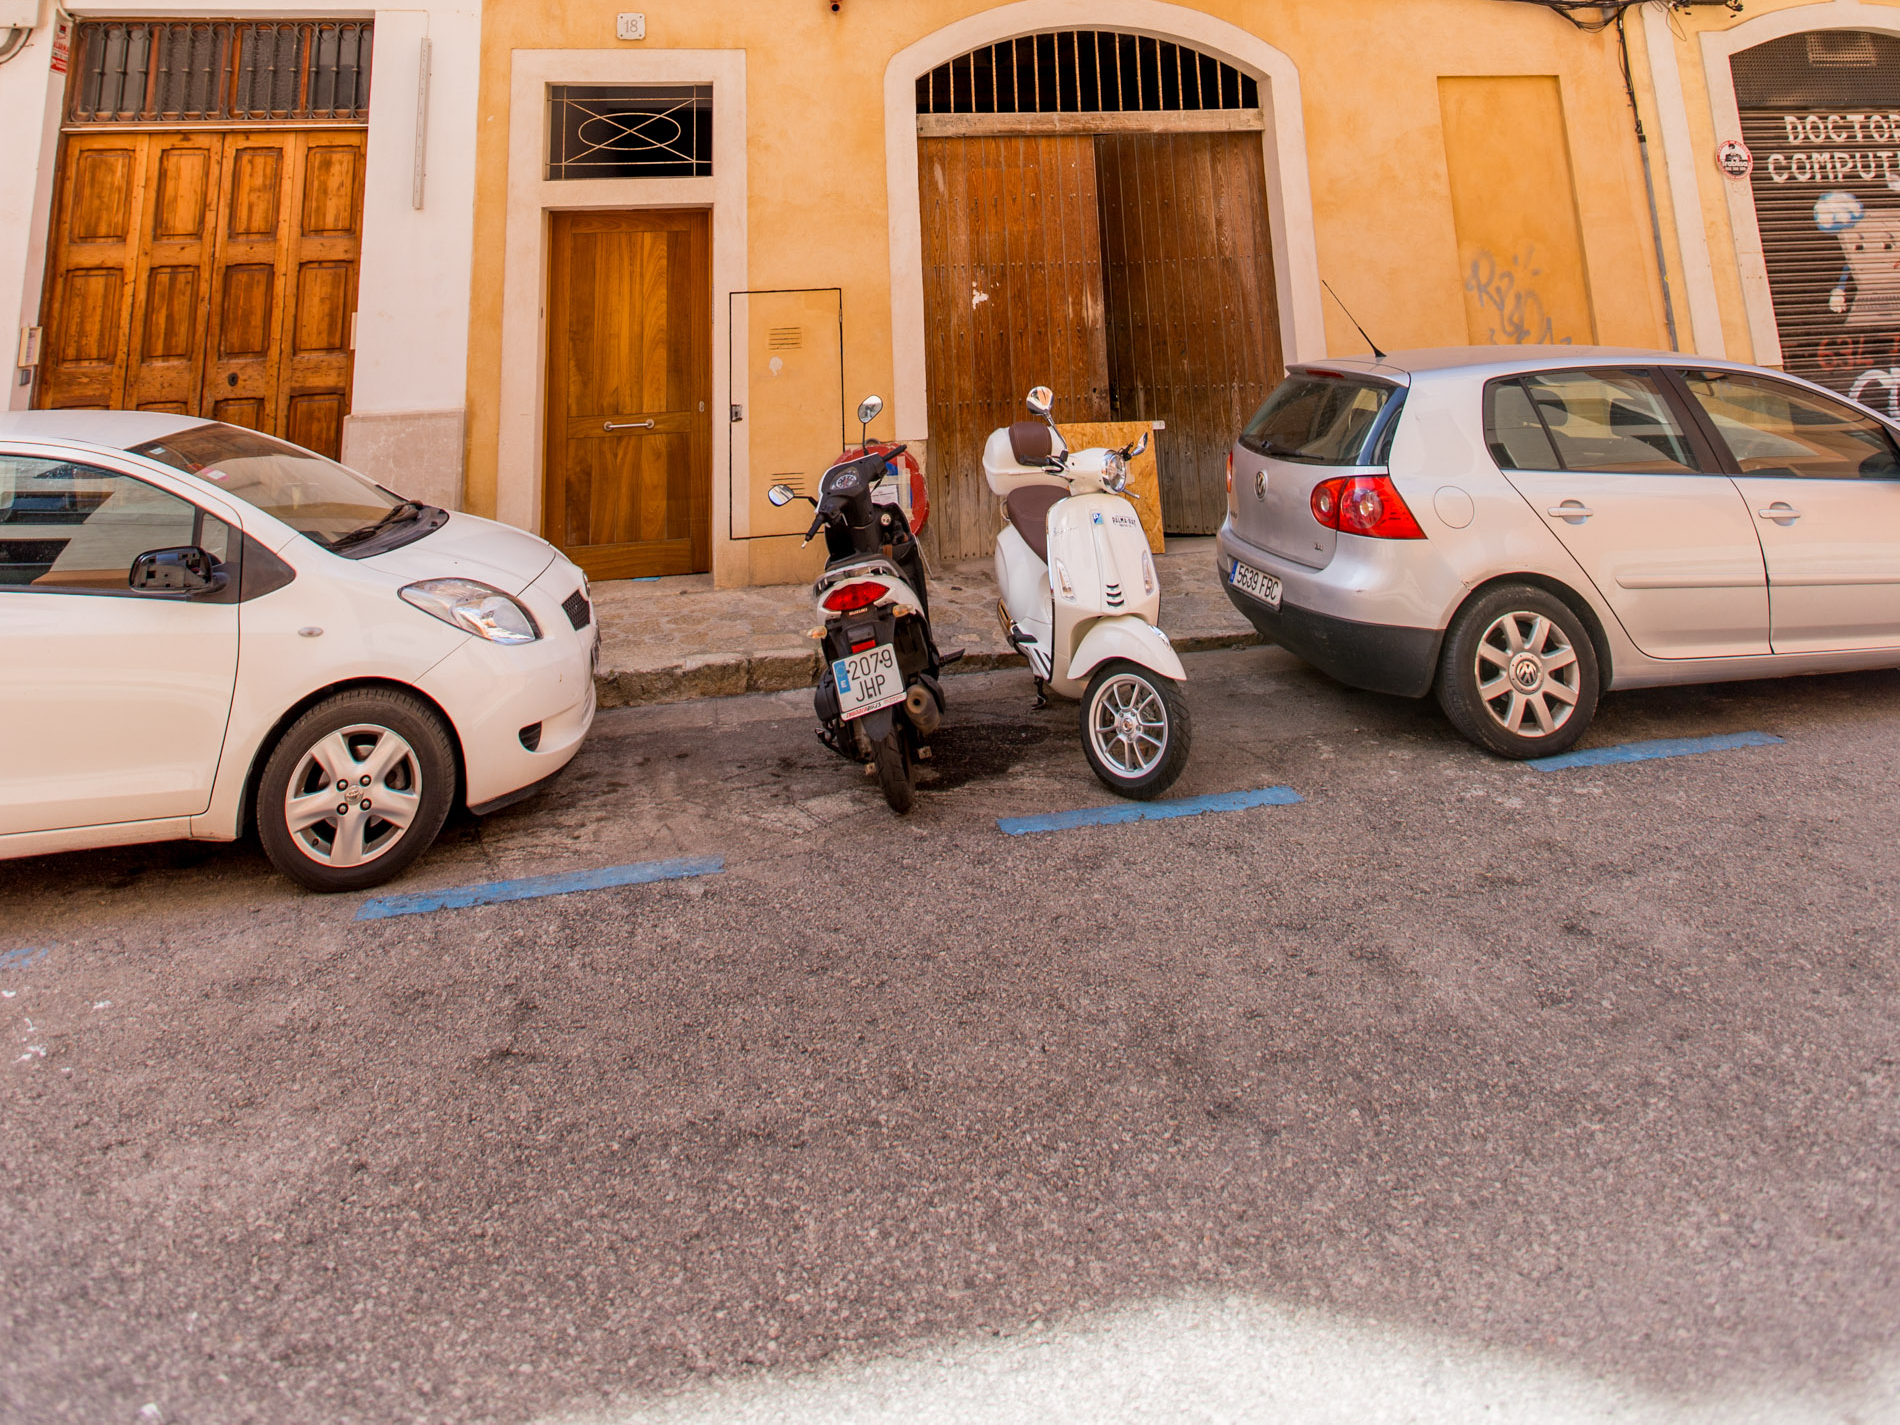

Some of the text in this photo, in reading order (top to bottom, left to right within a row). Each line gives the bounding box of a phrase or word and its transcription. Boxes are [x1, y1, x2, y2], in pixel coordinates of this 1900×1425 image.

[624, 18, 639, 33] 18
[1767, 151, 1900, 183] COMPUT
[1237, 565, 1279, 600] 5639 FBC
[848, 649, 893, 681] 2079
[840, 679, 848, 689] E
[855, 674, 886, 702] JHP
